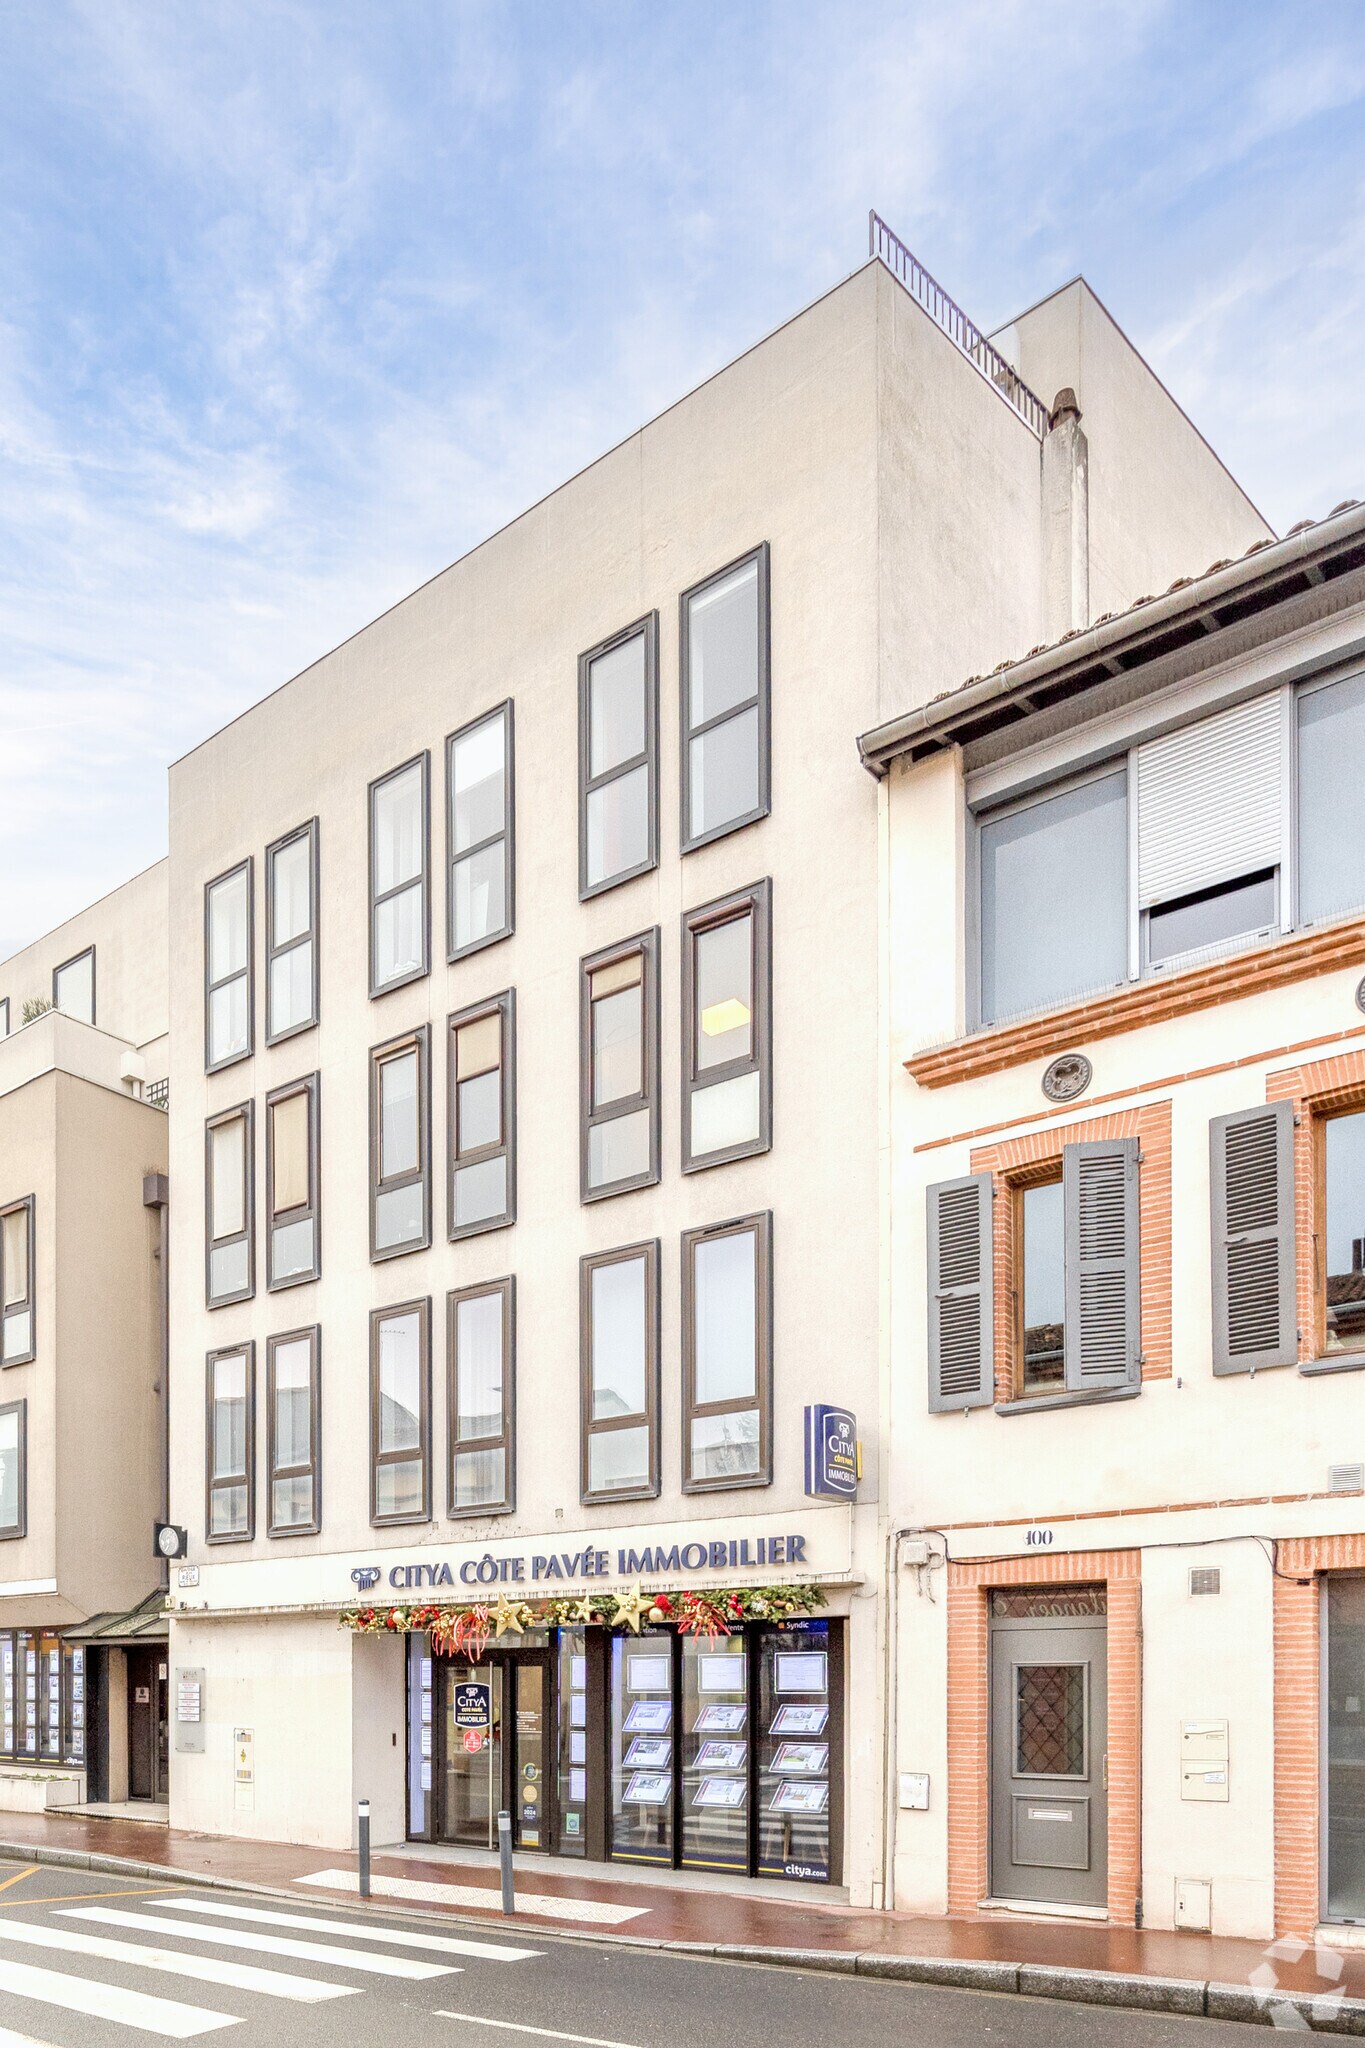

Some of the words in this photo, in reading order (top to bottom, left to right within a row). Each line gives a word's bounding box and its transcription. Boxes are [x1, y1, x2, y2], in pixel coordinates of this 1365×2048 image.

[828, 1435, 855, 1458] CITYA
[1025, 1530, 1054, 1545] 100
[388, 1562, 454, 1589] CITYA
[459, 1553, 526, 1584] CÔTE
[532, 1545, 609, 1580] PAVÉE
[617, 1534, 807, 1575] IMMOBILIER
[786, 1621, 809, 1631] Syndic
[457, 1695, 487, 1707] CITYA
[785, 1863, 827, 1878] citya.com
